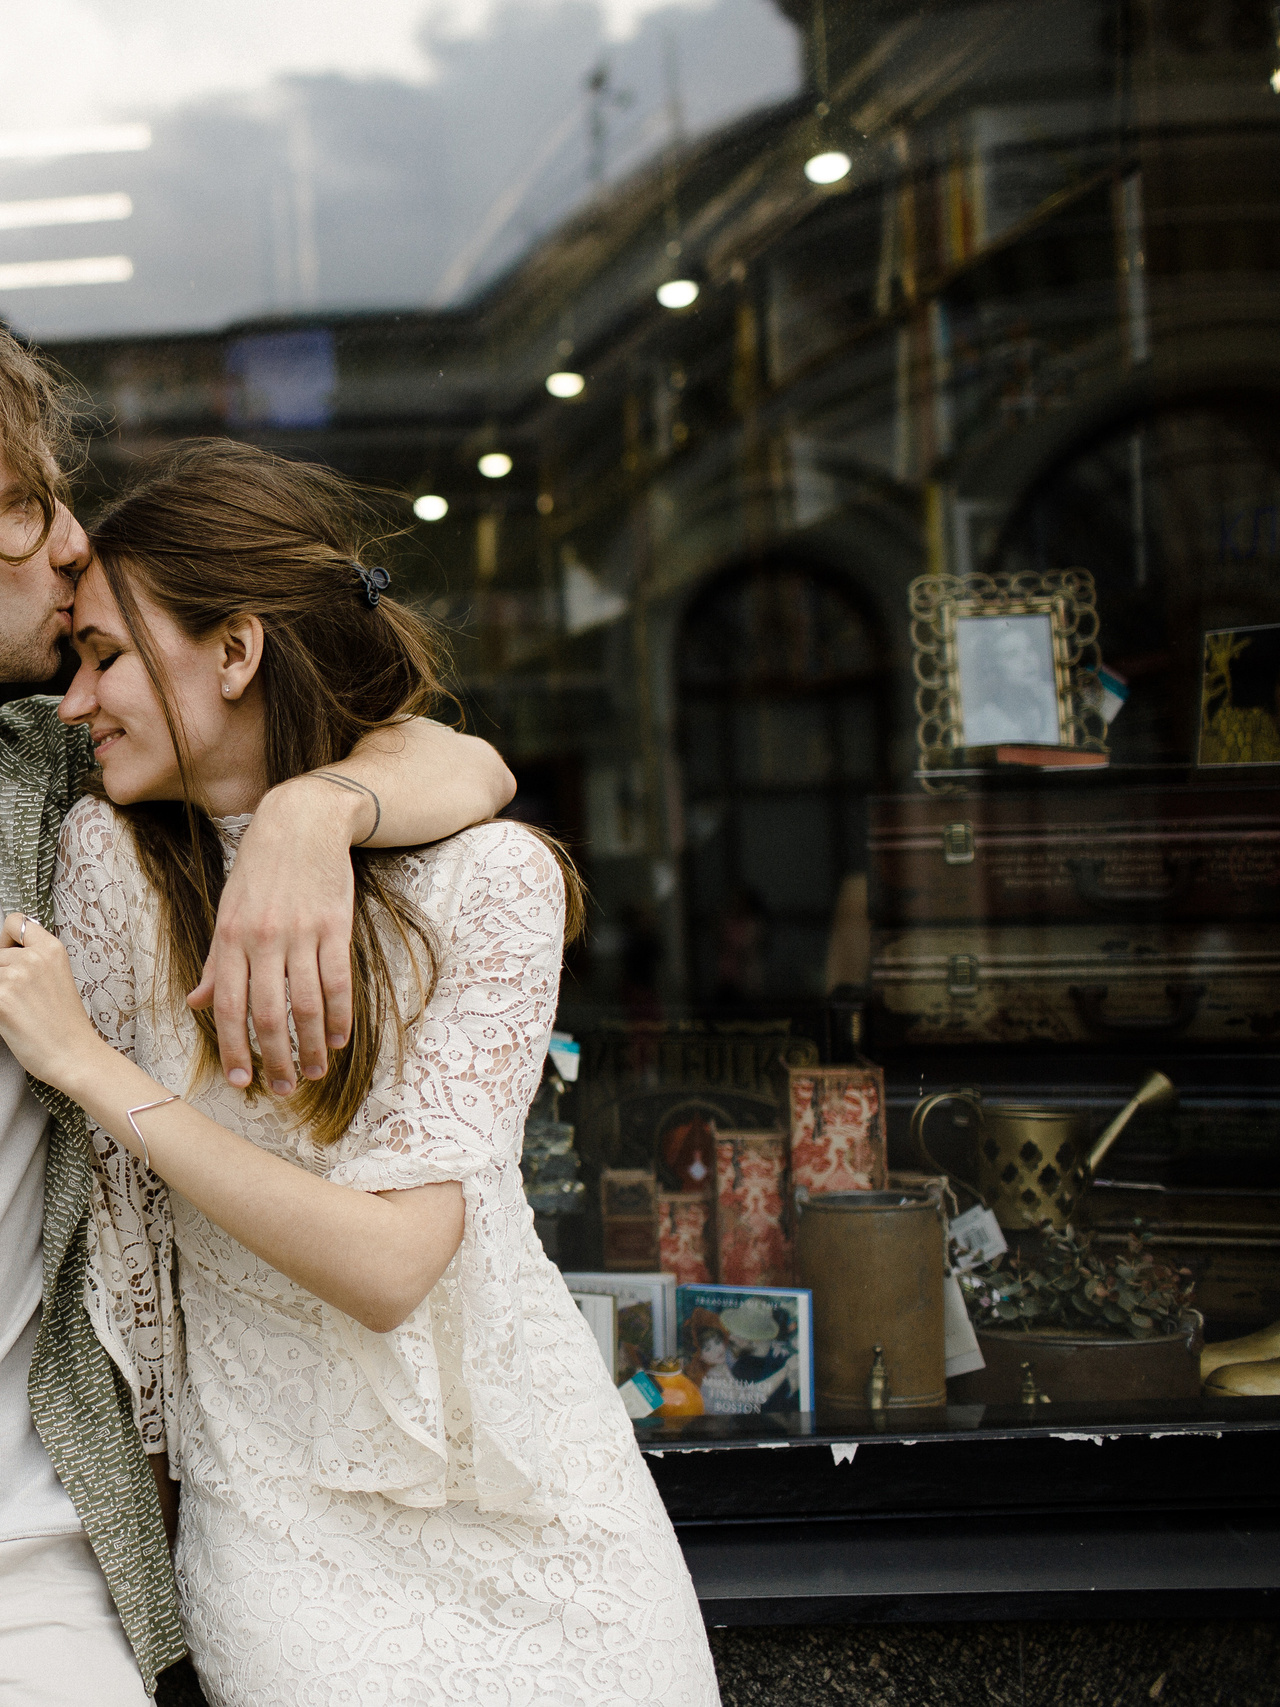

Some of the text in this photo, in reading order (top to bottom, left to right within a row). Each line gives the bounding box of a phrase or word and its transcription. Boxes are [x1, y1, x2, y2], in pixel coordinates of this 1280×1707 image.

[703, 1376, 756, 1390] MUSEUM
[739, 1391, 767, 1404] ARTS
[714, 1401, 762, 1415] BOSTON
